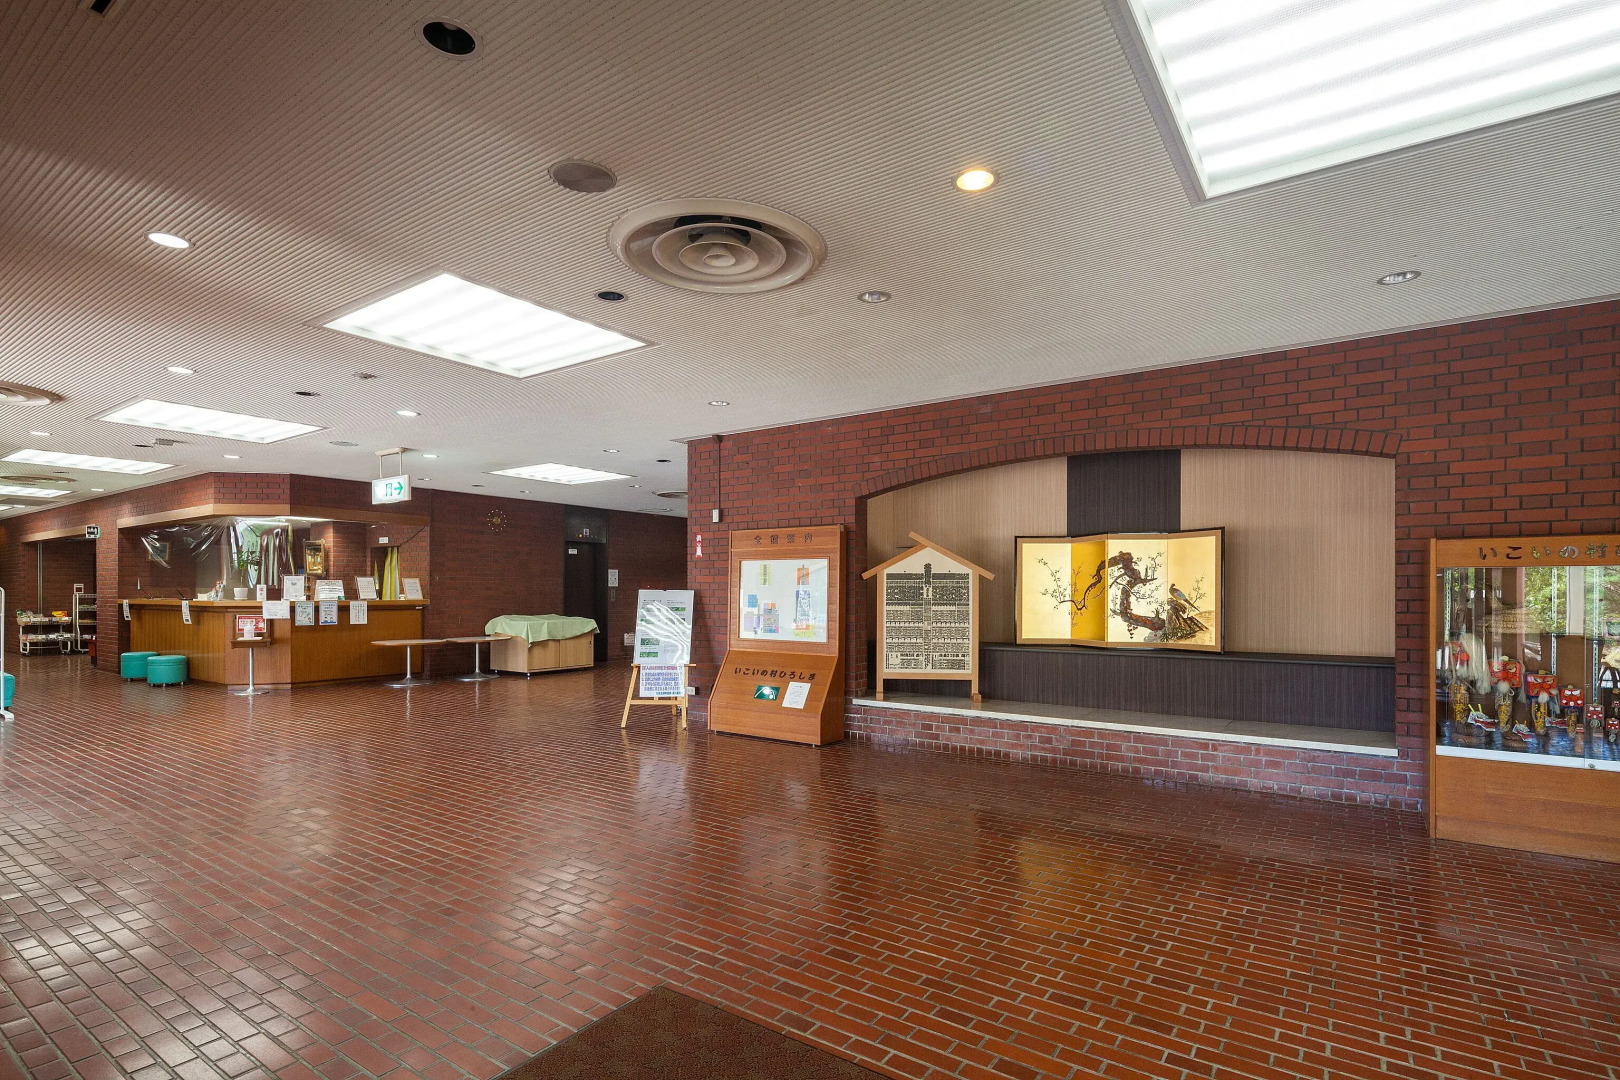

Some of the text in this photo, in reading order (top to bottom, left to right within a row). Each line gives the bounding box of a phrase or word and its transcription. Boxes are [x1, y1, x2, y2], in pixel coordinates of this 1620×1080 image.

[1478, 543, 1620, 561] いこいの村
[734, 667, 816, 681] いこいの村ひろしま
